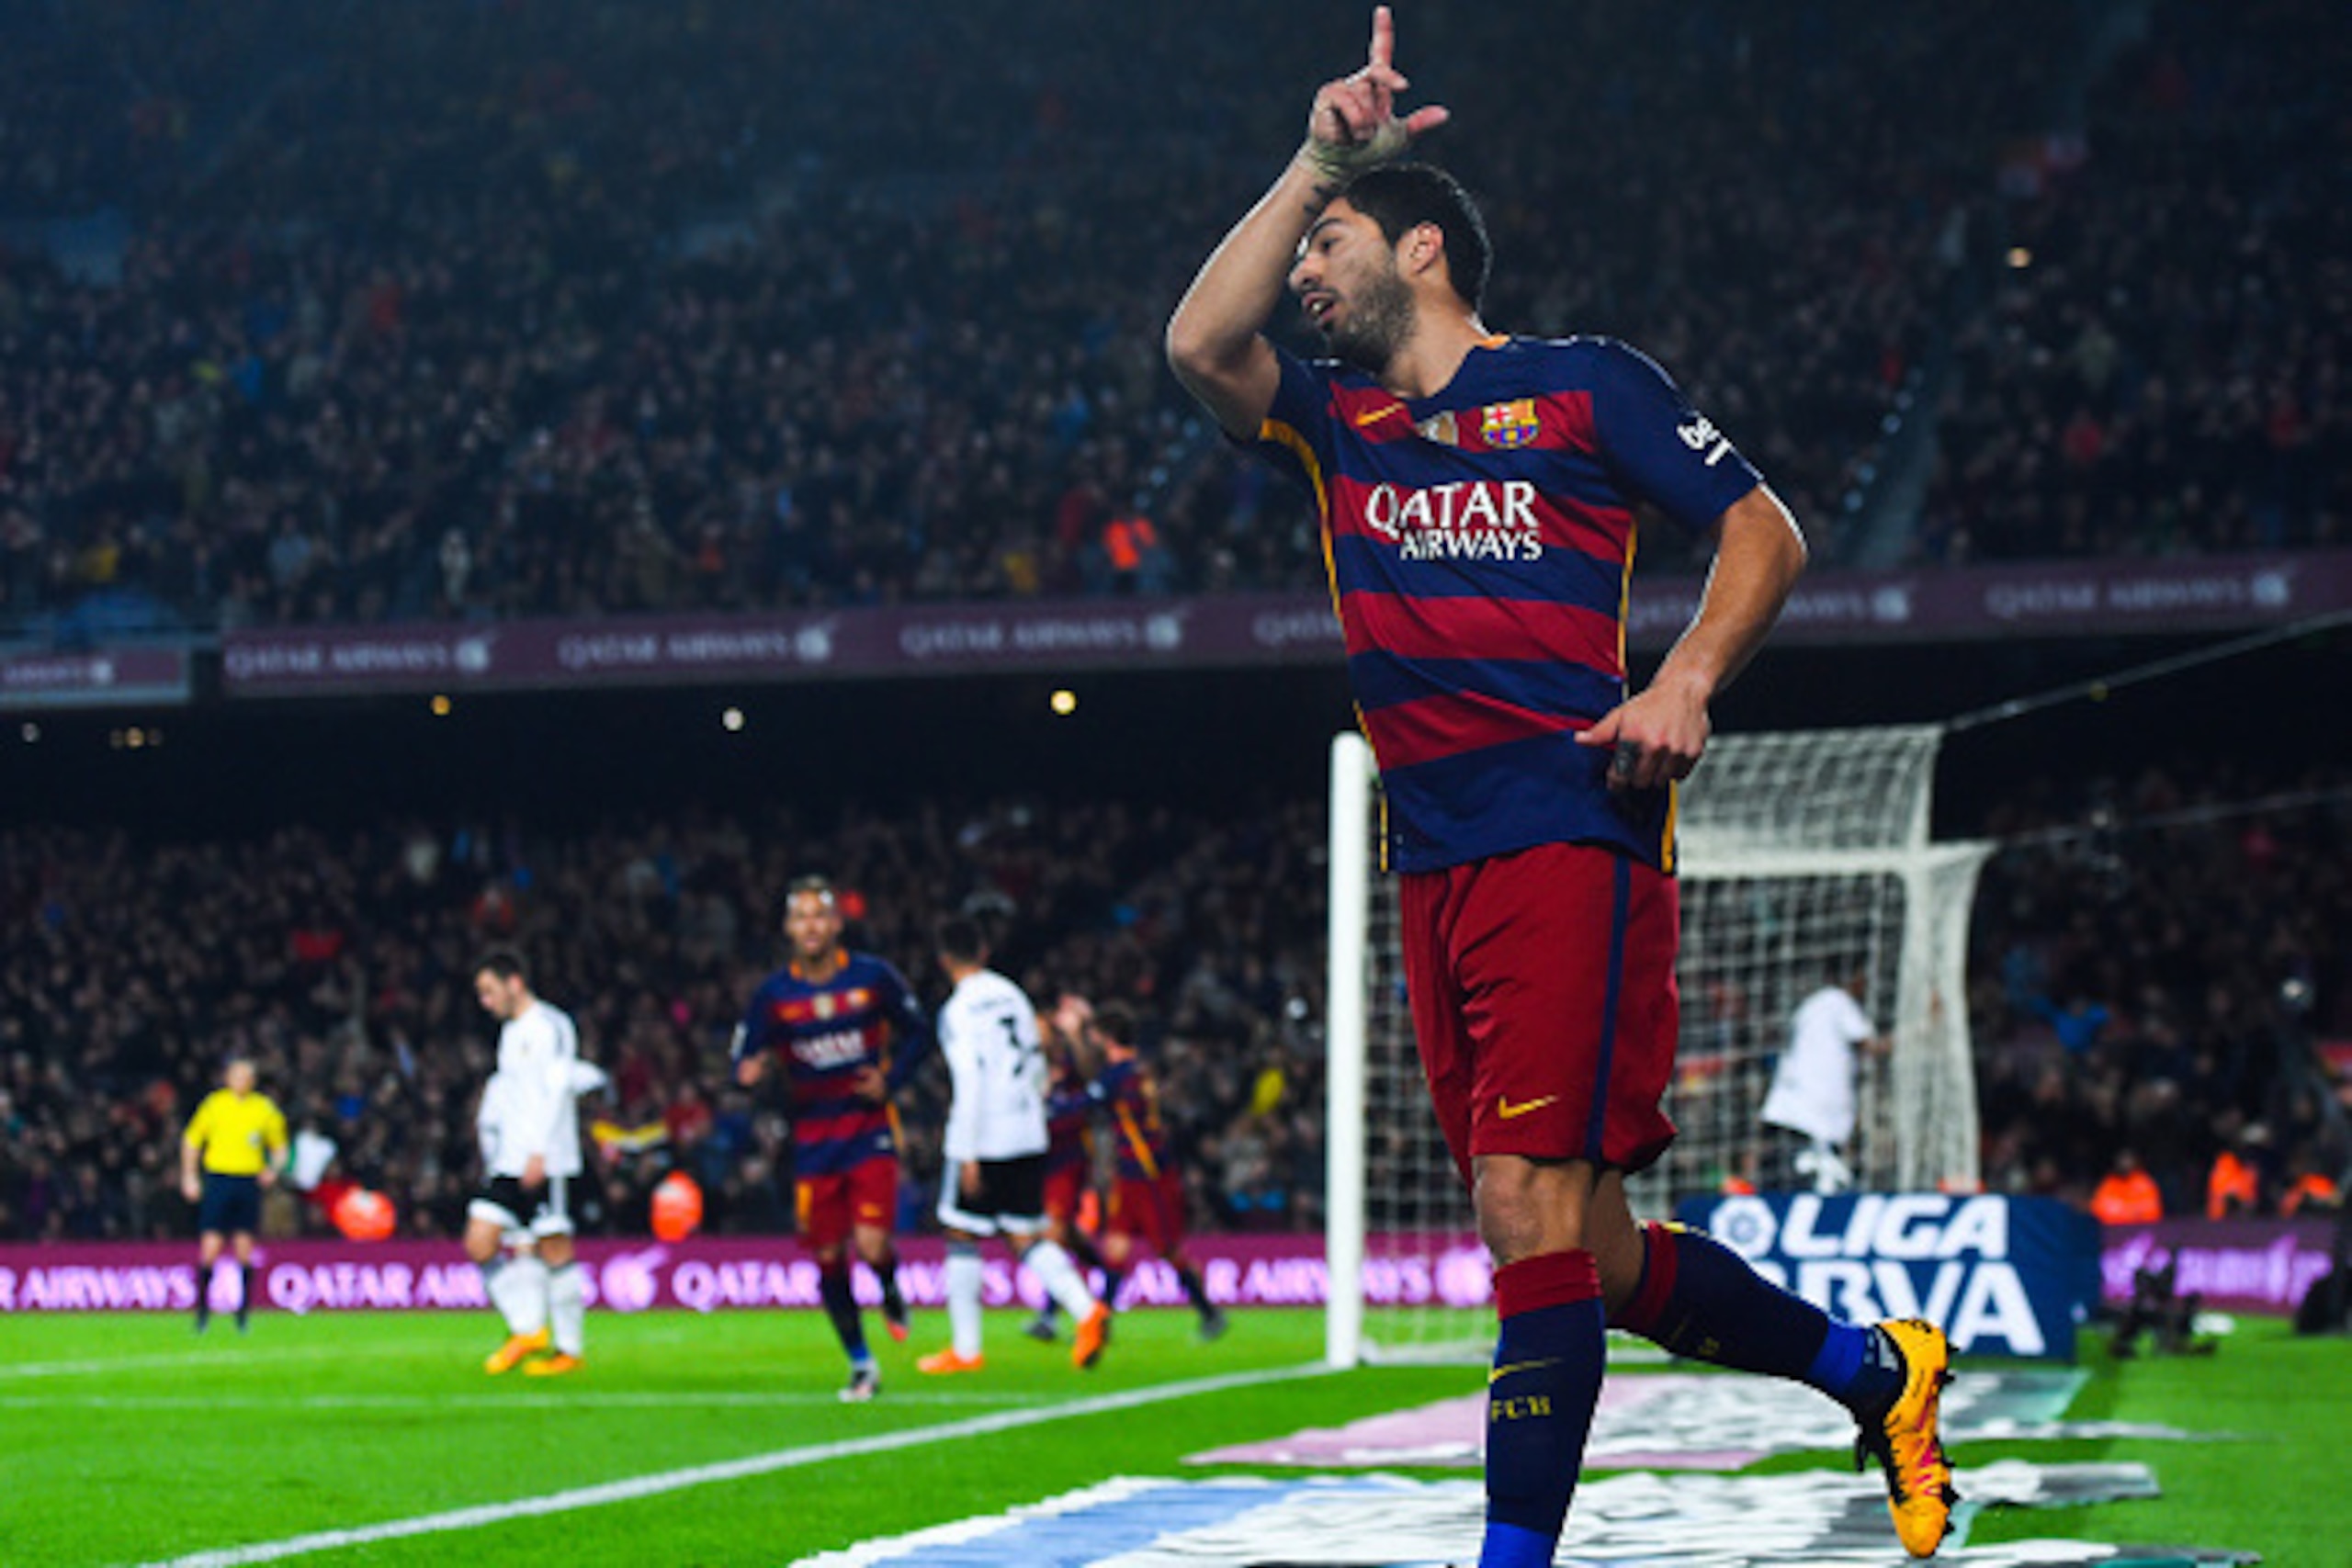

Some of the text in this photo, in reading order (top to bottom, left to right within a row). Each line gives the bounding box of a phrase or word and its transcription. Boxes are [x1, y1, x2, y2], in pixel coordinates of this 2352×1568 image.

[1364, 480, 1540, 540] QATAR
[1399, 528, 1544, 560] AIRWAYS
[1781, 1194, 2008, 1258] LIGA
[21, 1263, 198, 1310] AIRWAYS
[266, 1262, 413, 1314] QATAR
[672, 1259, 821, 1312] QATAR
